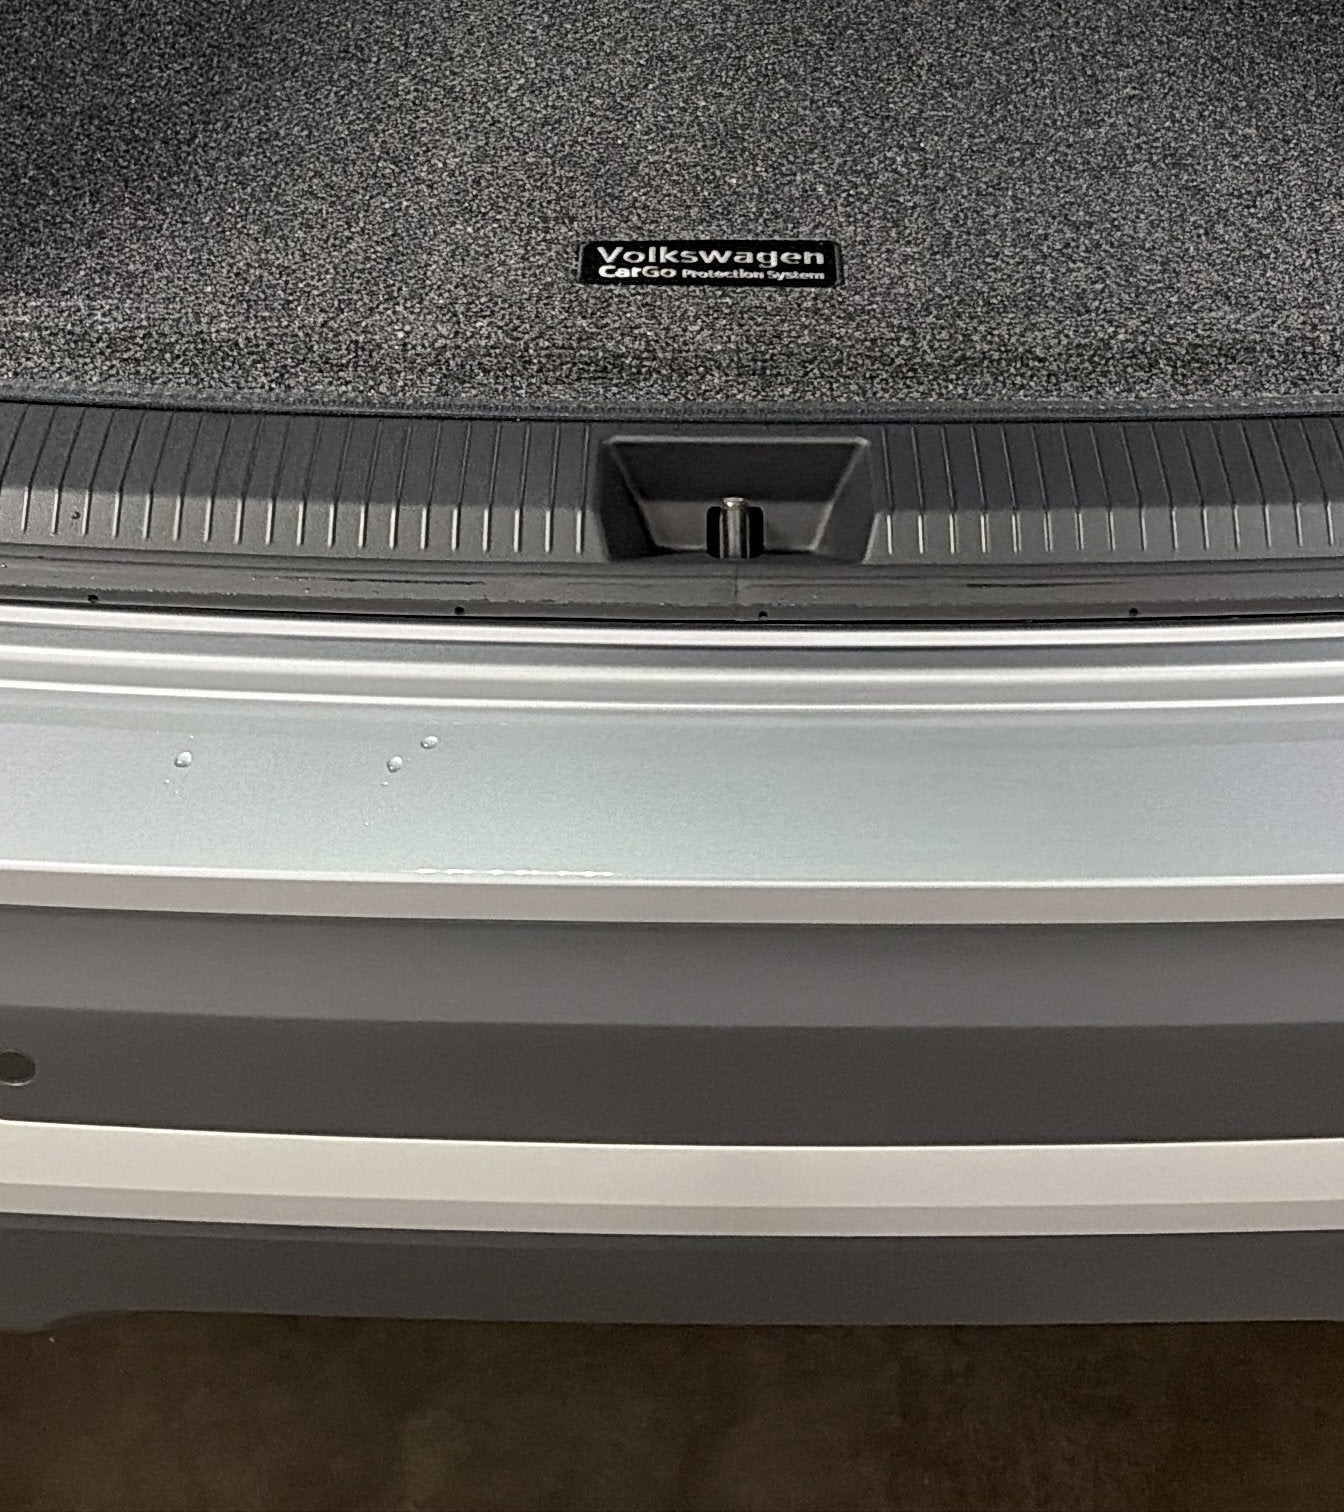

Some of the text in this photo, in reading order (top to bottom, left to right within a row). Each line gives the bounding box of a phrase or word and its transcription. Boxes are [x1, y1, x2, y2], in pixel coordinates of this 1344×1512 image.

[597, 246, 825, 268] Volkswagen
[598, 265, 825, 281] CarGo Protection System
